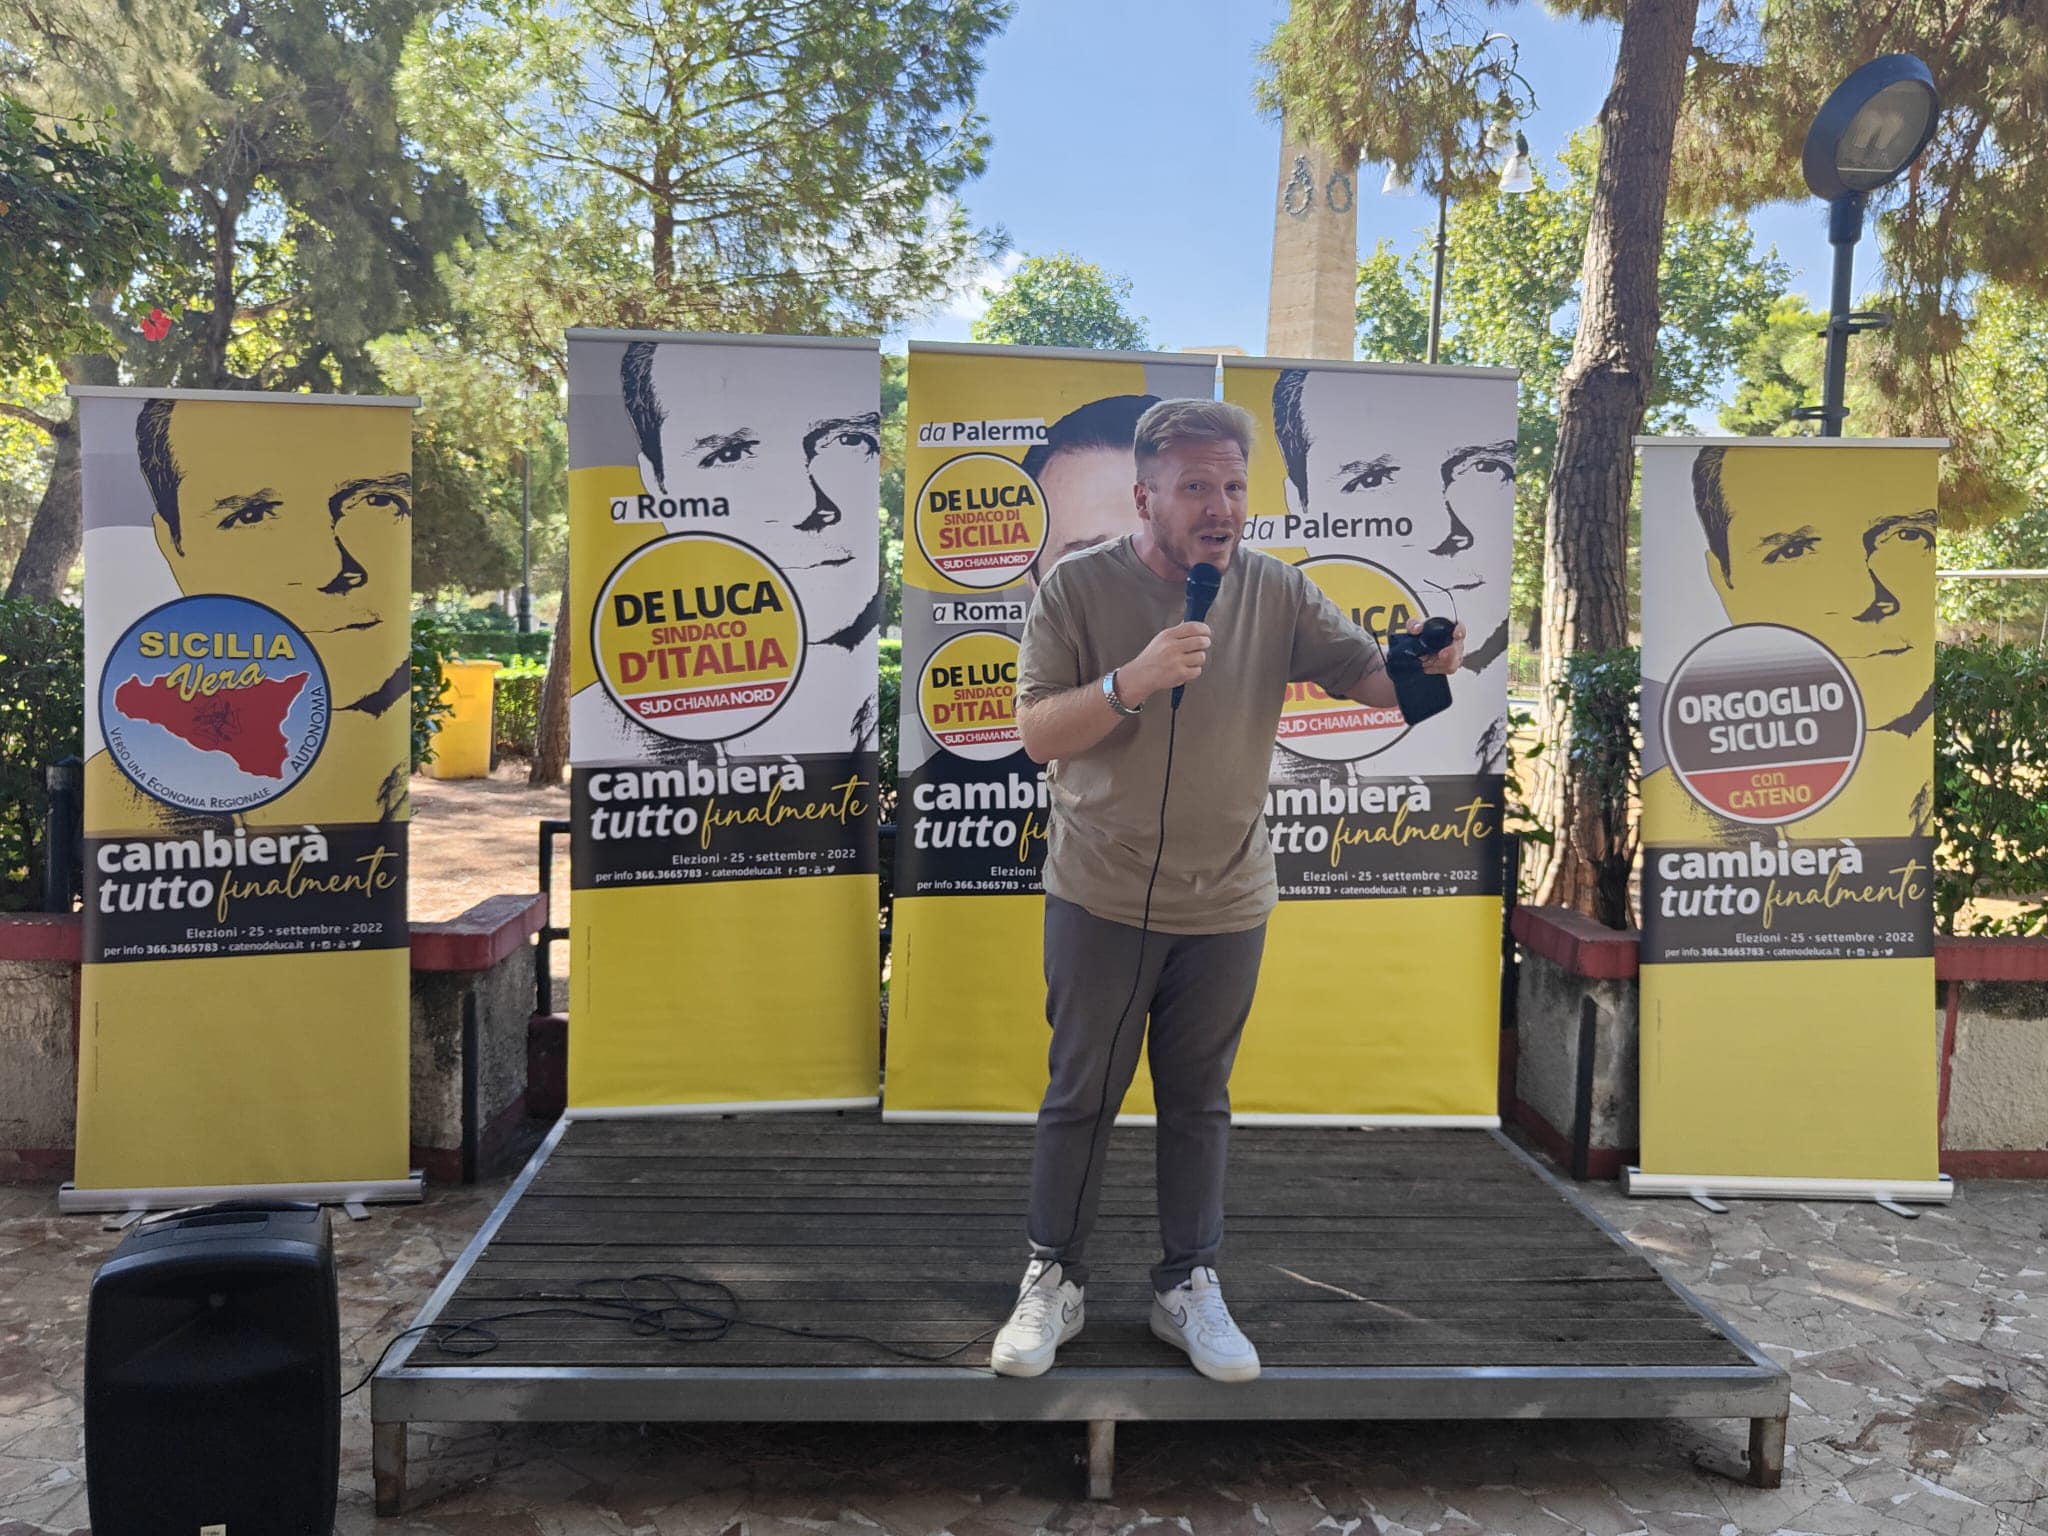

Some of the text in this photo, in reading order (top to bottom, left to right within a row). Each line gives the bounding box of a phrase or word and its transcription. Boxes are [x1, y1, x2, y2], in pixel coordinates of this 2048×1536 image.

[919, 421, 1048, 442] da Palermo
[610, 494, 729, 520] a Roma
[929, 485, 1035, 512] DE LUCA
[944, 509, 1020, 525] SINDACO DI
[1241, 513, 1413, 541] da Palermo
[938, 522, 1030, 549] SICILIA
[943, 554, 1028, 570] SUD CHIAMA NORD
[614, 580, 784, 627] DE LUCA
[933, 602, 1023, 622] a Roma
[139, 631, 296, 659] SICILIA
[651, 620, 747, 645] SINDACO
[618, 637, 788, 684] D'ITALIA
[165, 662, 266, 702] Vera
[931, 662, 1017, 688] DE LUC
[639, 688, 776, 715] SUD CHIAMA NORD
[954, 686, 1013, 701] SINDACO
[1678, 682, 1844, 724] ORGOGLIO
[933, 699, 1016, 725] D'ITAL
[1278, 719, 1307, 734] SUD
[1309, 715, 1362, 731] CHIAMA
[290, 685, 325, 773] AUTONOMA
[944, 729, 1022, 744] SUD CHIAMA NOR
[1709, 718, 1819, 754] SICULO
[588, 755, 805, 801] cambierà
[1751, 771, 1785, 788] con
[912, 772, 1048, 811] cambi
[1728, 785, 1812, 810] CATENO
[590, 774, 869, 850] tutto finalmente
[913, 815, 1017, 850] tutto
[1267, 797, 1495, 868] tto finalmente
[97, 825, 328, 873] cambierà
[672, 849, 856, 865] Elezioni 25 settembre 2022
[1658, 838, 1863, 881] cambierà
[99, 845, 398, 923] tutto finalmente
[595, 866, 782, 883] per info 366.3665783 catenodeluca.it
[990, 866, 1037, 877] Elezioni
[1303, 870, 1478, 882] Elezioni 25 settembre 2022
[916, 880, 933, 891] per
[933, 879, 953, 890] info
[954, 880, 1019, 890] 366.3665783
[1279, 885, 1407, 896] 6.3665783 catenodeluca.it
[1660, 858, 1927, 930] tutto finalmente
[186, 922, 383, 939] Elezioni 25 settembre 2022
[1735, 932, 1915, 944] Elezioni 25 settembre 2022
[104, 940, 304, 957] per info 366.3665783 catenodeluca.it
[1664, 948, 1680, 958] per
[1681, 946, 1700, 957] info
[1772, 946, 1841, 957] catenodeluca.it
